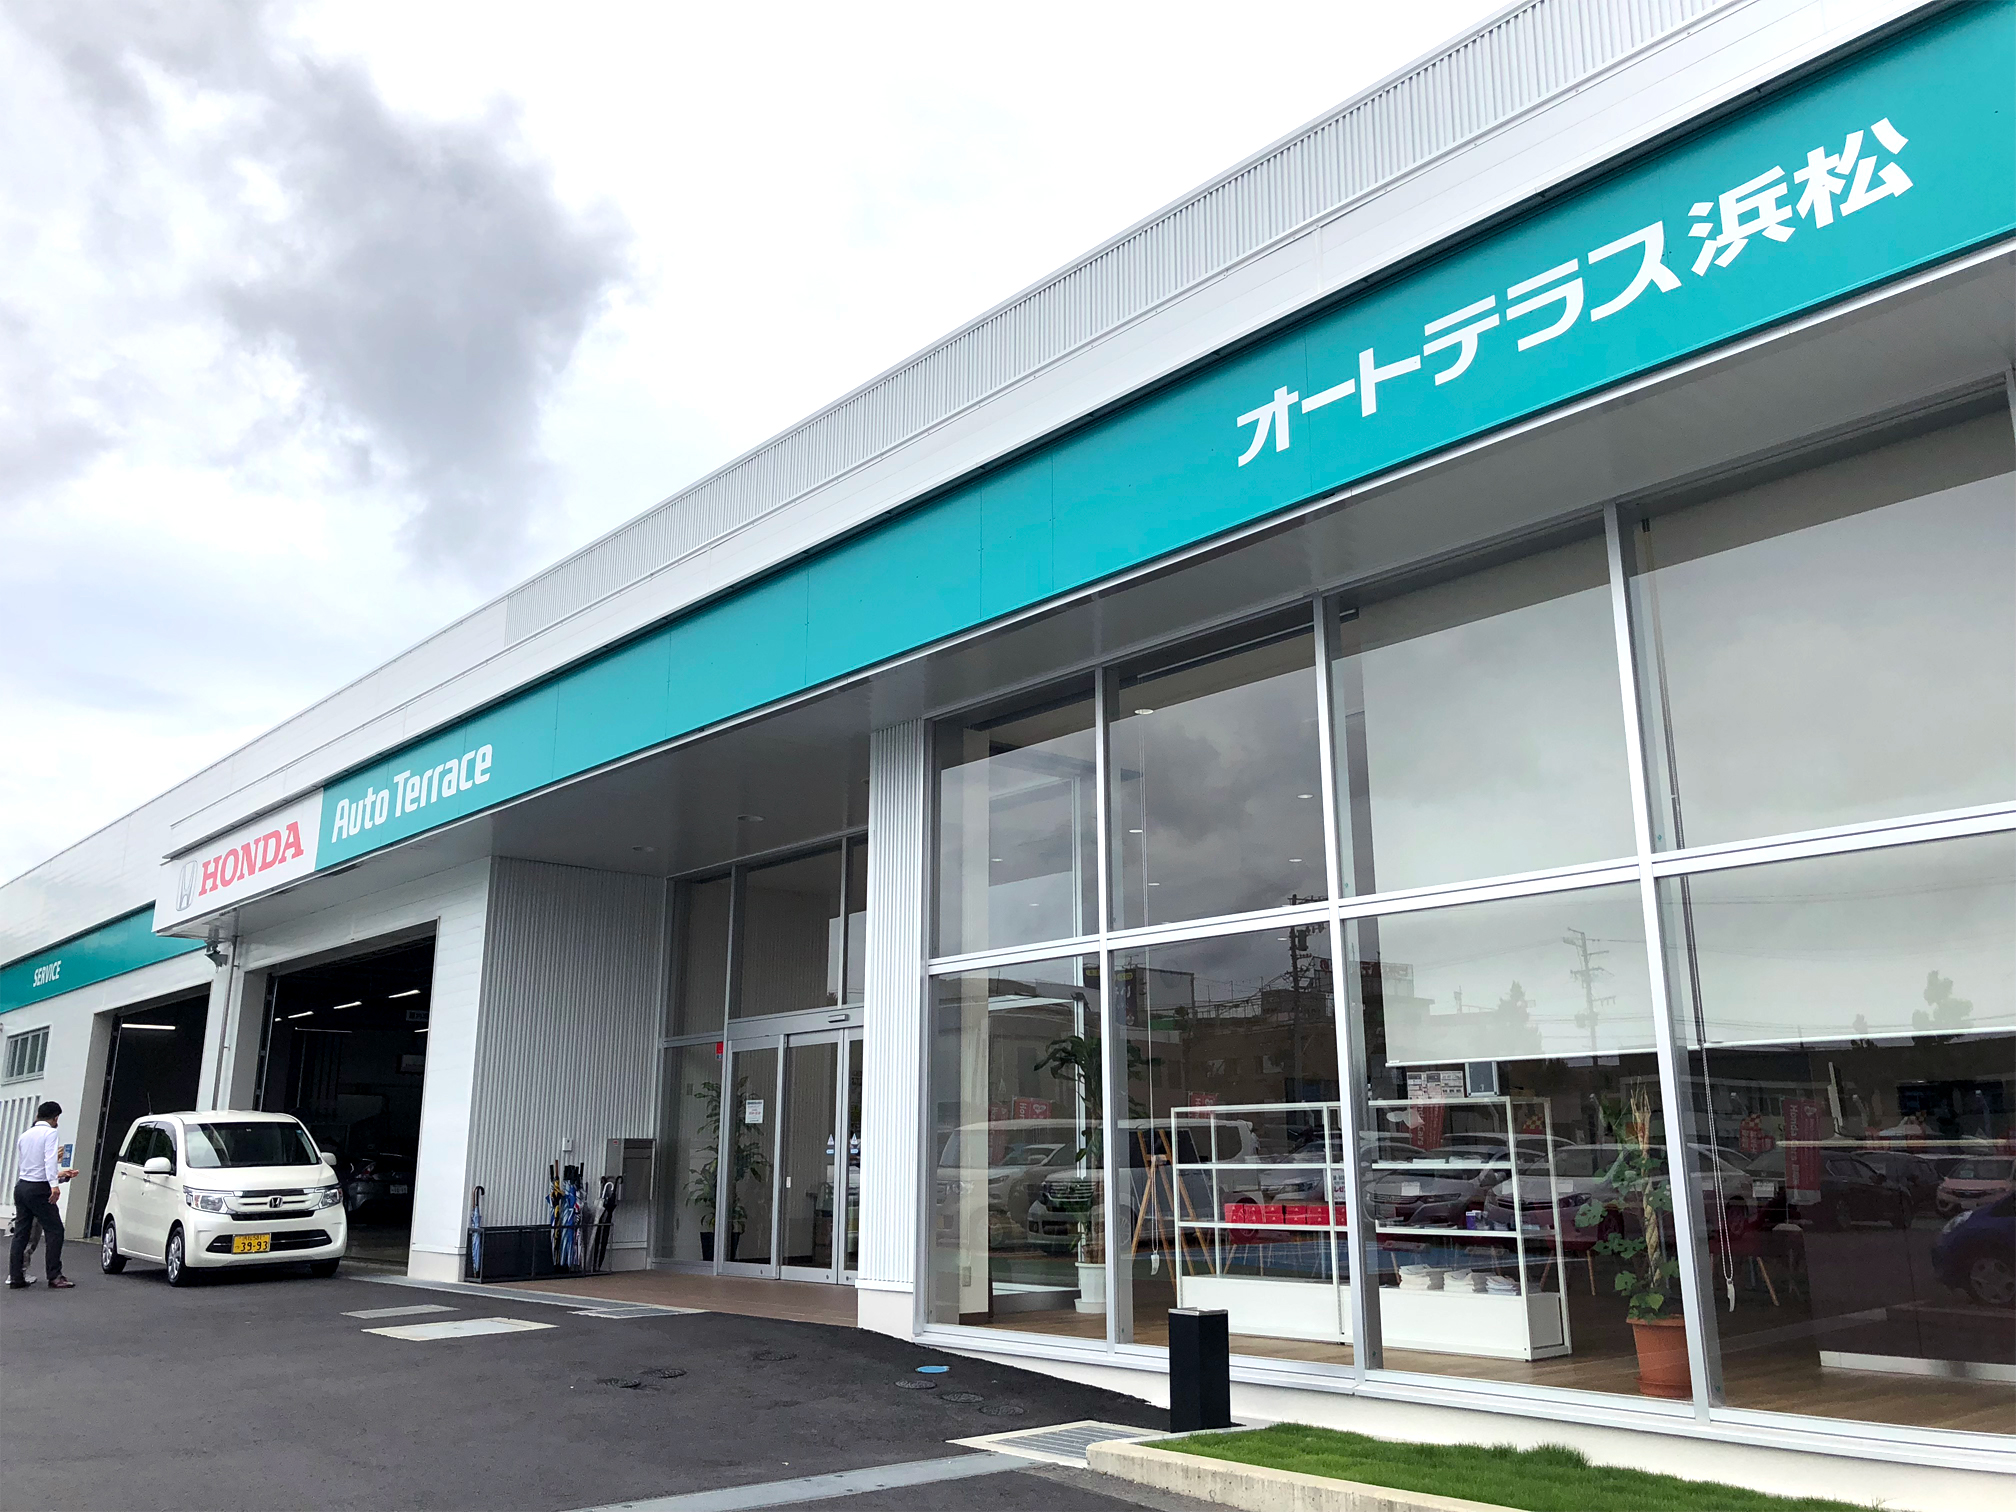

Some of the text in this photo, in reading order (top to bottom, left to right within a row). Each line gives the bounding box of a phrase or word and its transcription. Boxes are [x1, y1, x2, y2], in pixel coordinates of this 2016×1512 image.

[1237, 117, 1914, 467] オートテラス浜松
[331, 743, 492, 844] Auto Terrace
[198, 821, 304, 897] HONDA
[32, 960, 62, 988] SERVICE
[240, 1240, 268, 1252] 39-93
